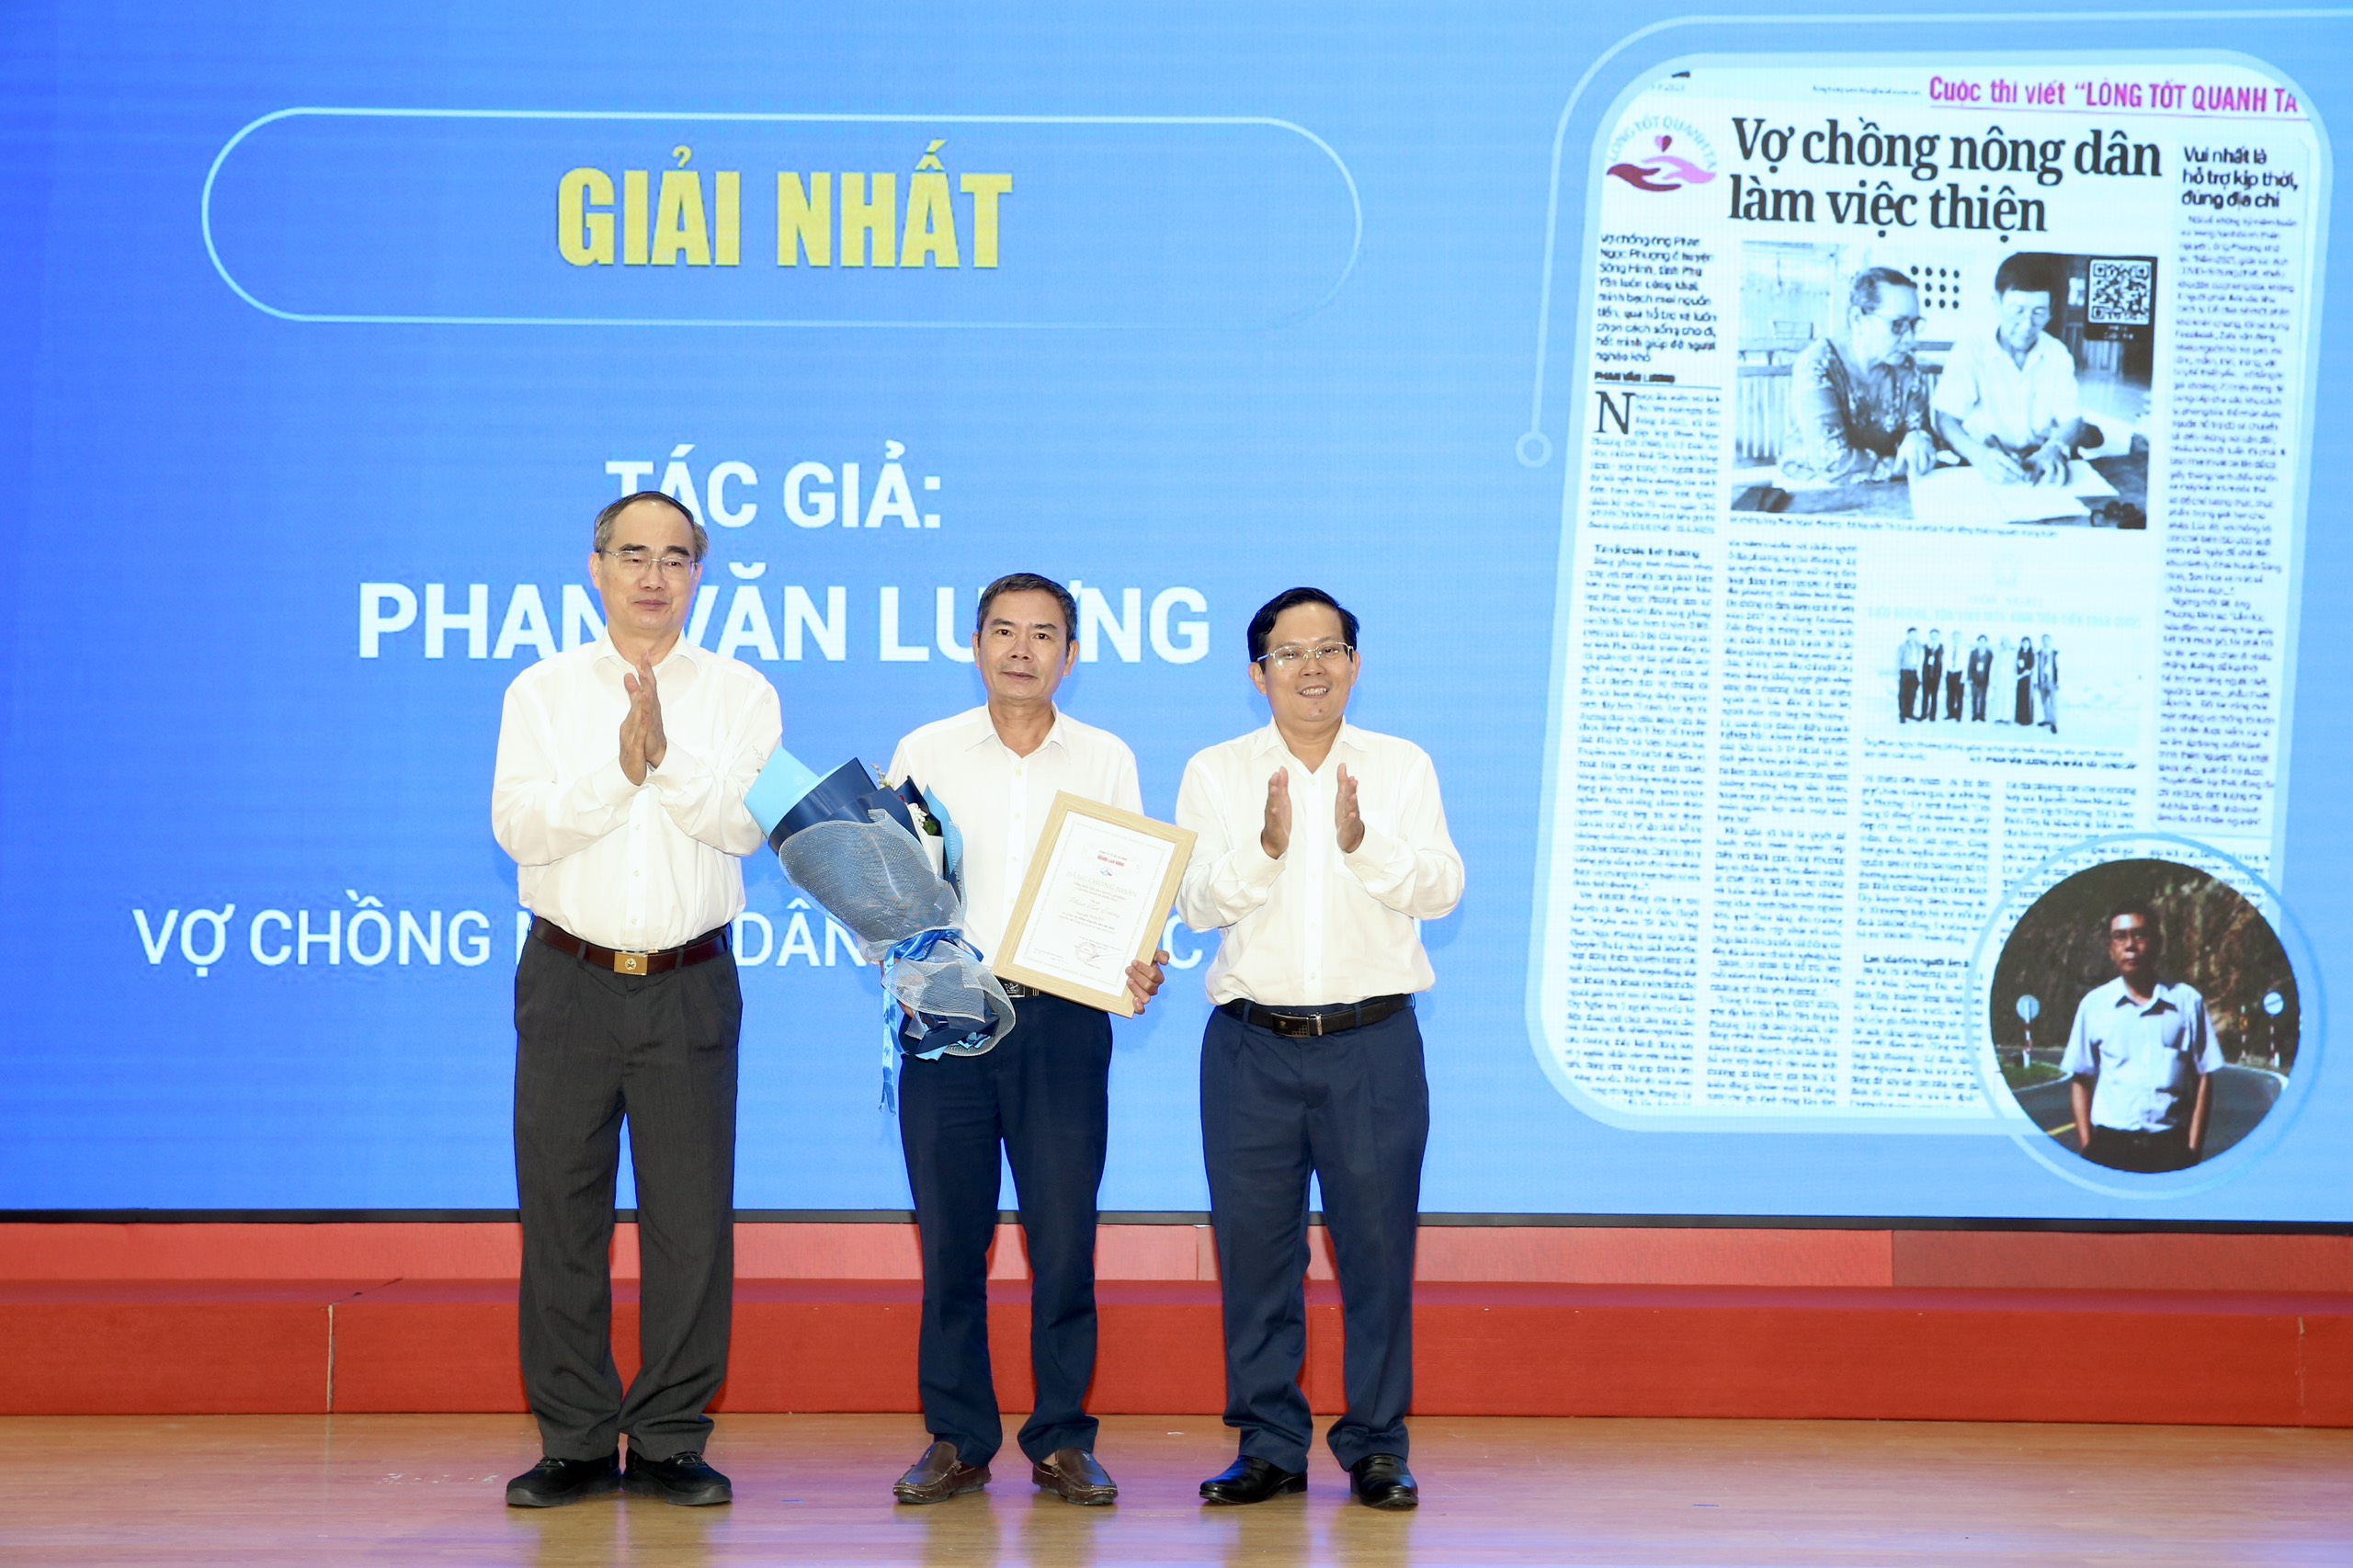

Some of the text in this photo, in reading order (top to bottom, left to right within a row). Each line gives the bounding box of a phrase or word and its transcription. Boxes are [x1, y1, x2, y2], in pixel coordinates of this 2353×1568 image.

[2192, 85, 2268, 112] QUANH
[1732, 117, 2162, 187] Vợ chồng nông dân
[2184, 146, 2209, 163] Vui
[557, 139, 1013, 268] GIẢI NHẤT
[1728, 174, 2048, 243] làm việc thiện
[606, 440, 941, 529] TÁC GIẢ:
[132, 903, 235, 977] VỢ
[249, 889, 491, 967] CHỒNG
